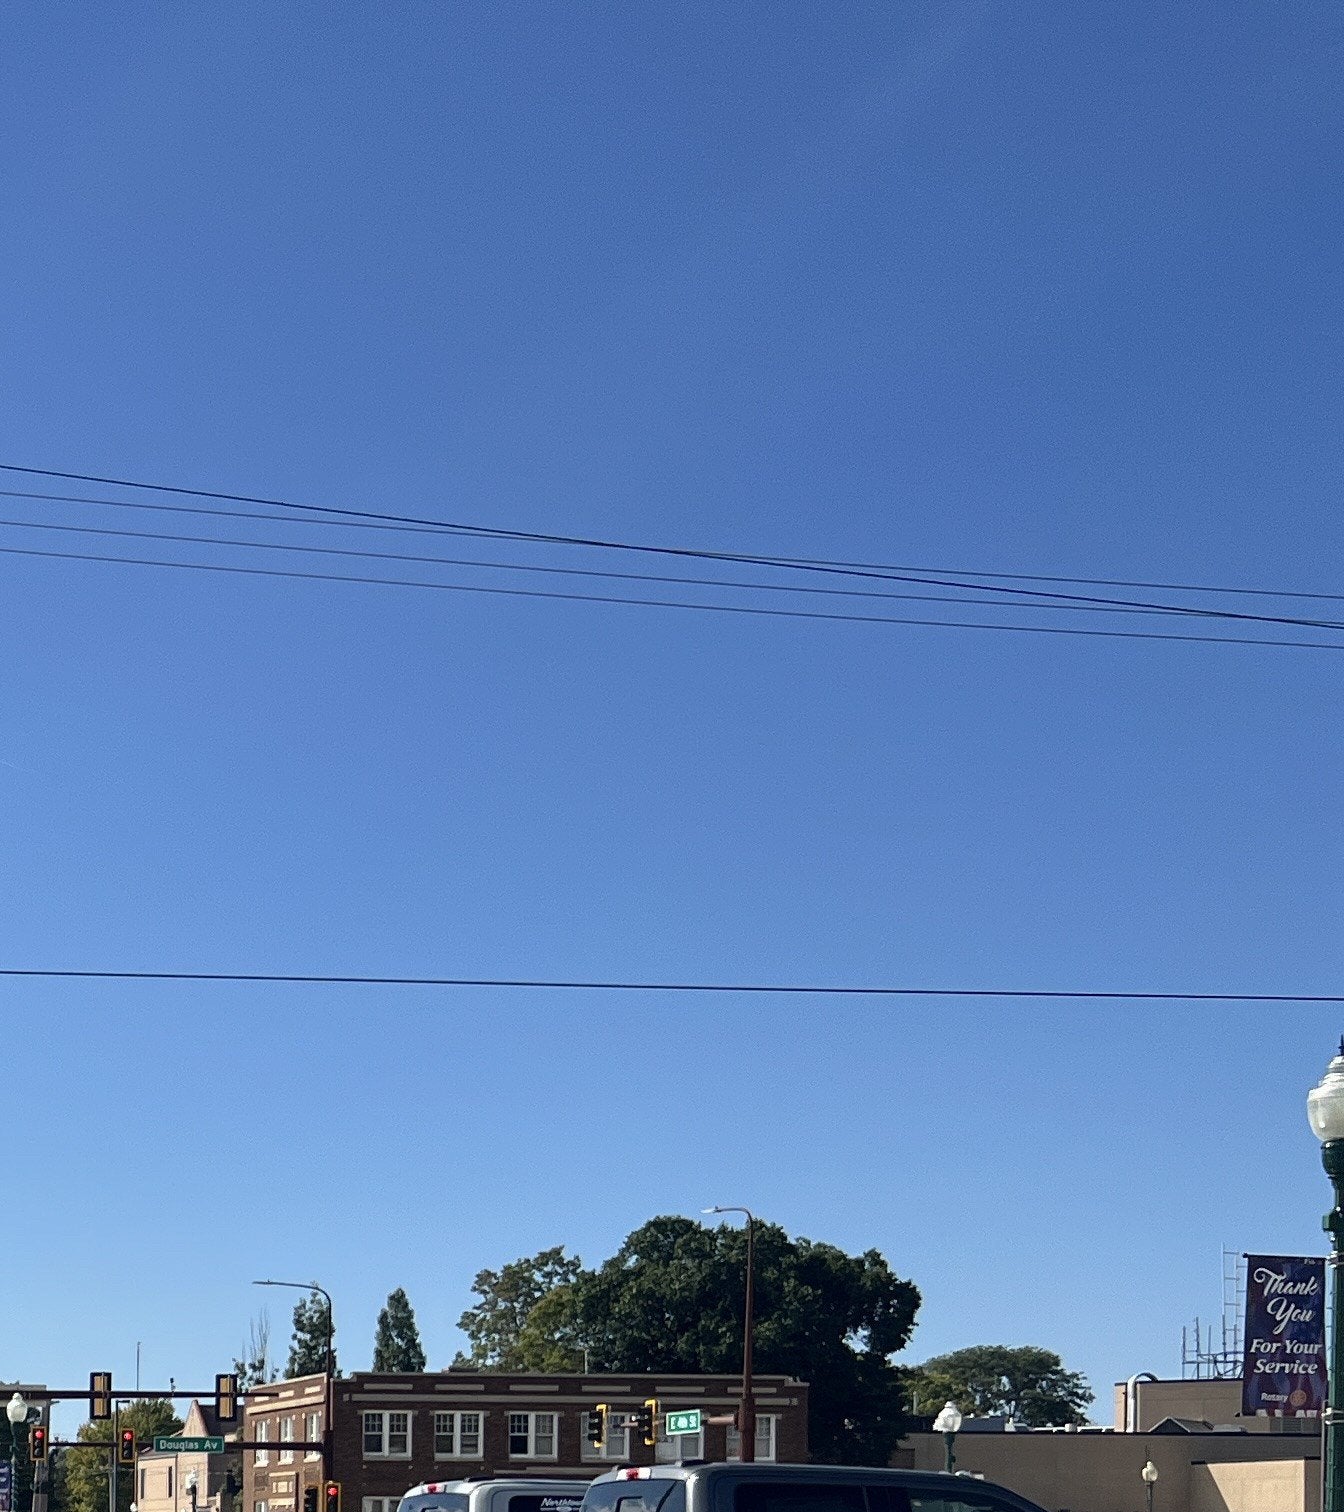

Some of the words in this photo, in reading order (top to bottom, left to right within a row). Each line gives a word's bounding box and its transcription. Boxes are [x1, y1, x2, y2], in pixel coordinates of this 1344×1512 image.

[1253, 1267, 1318, 1297] Thank
[1266, 1297, 1314, 1335] You
[1250, 1338, 1281, 1353] For
[1285, 1339, 1323, 1354] Your
[1254, 1358, 1318, 1374] Service
[1261, 1392, 1288, 1403] Rotary
[159, 1440, 199, 1451] Douglas
[204, 1440, 218, 1449] Av
